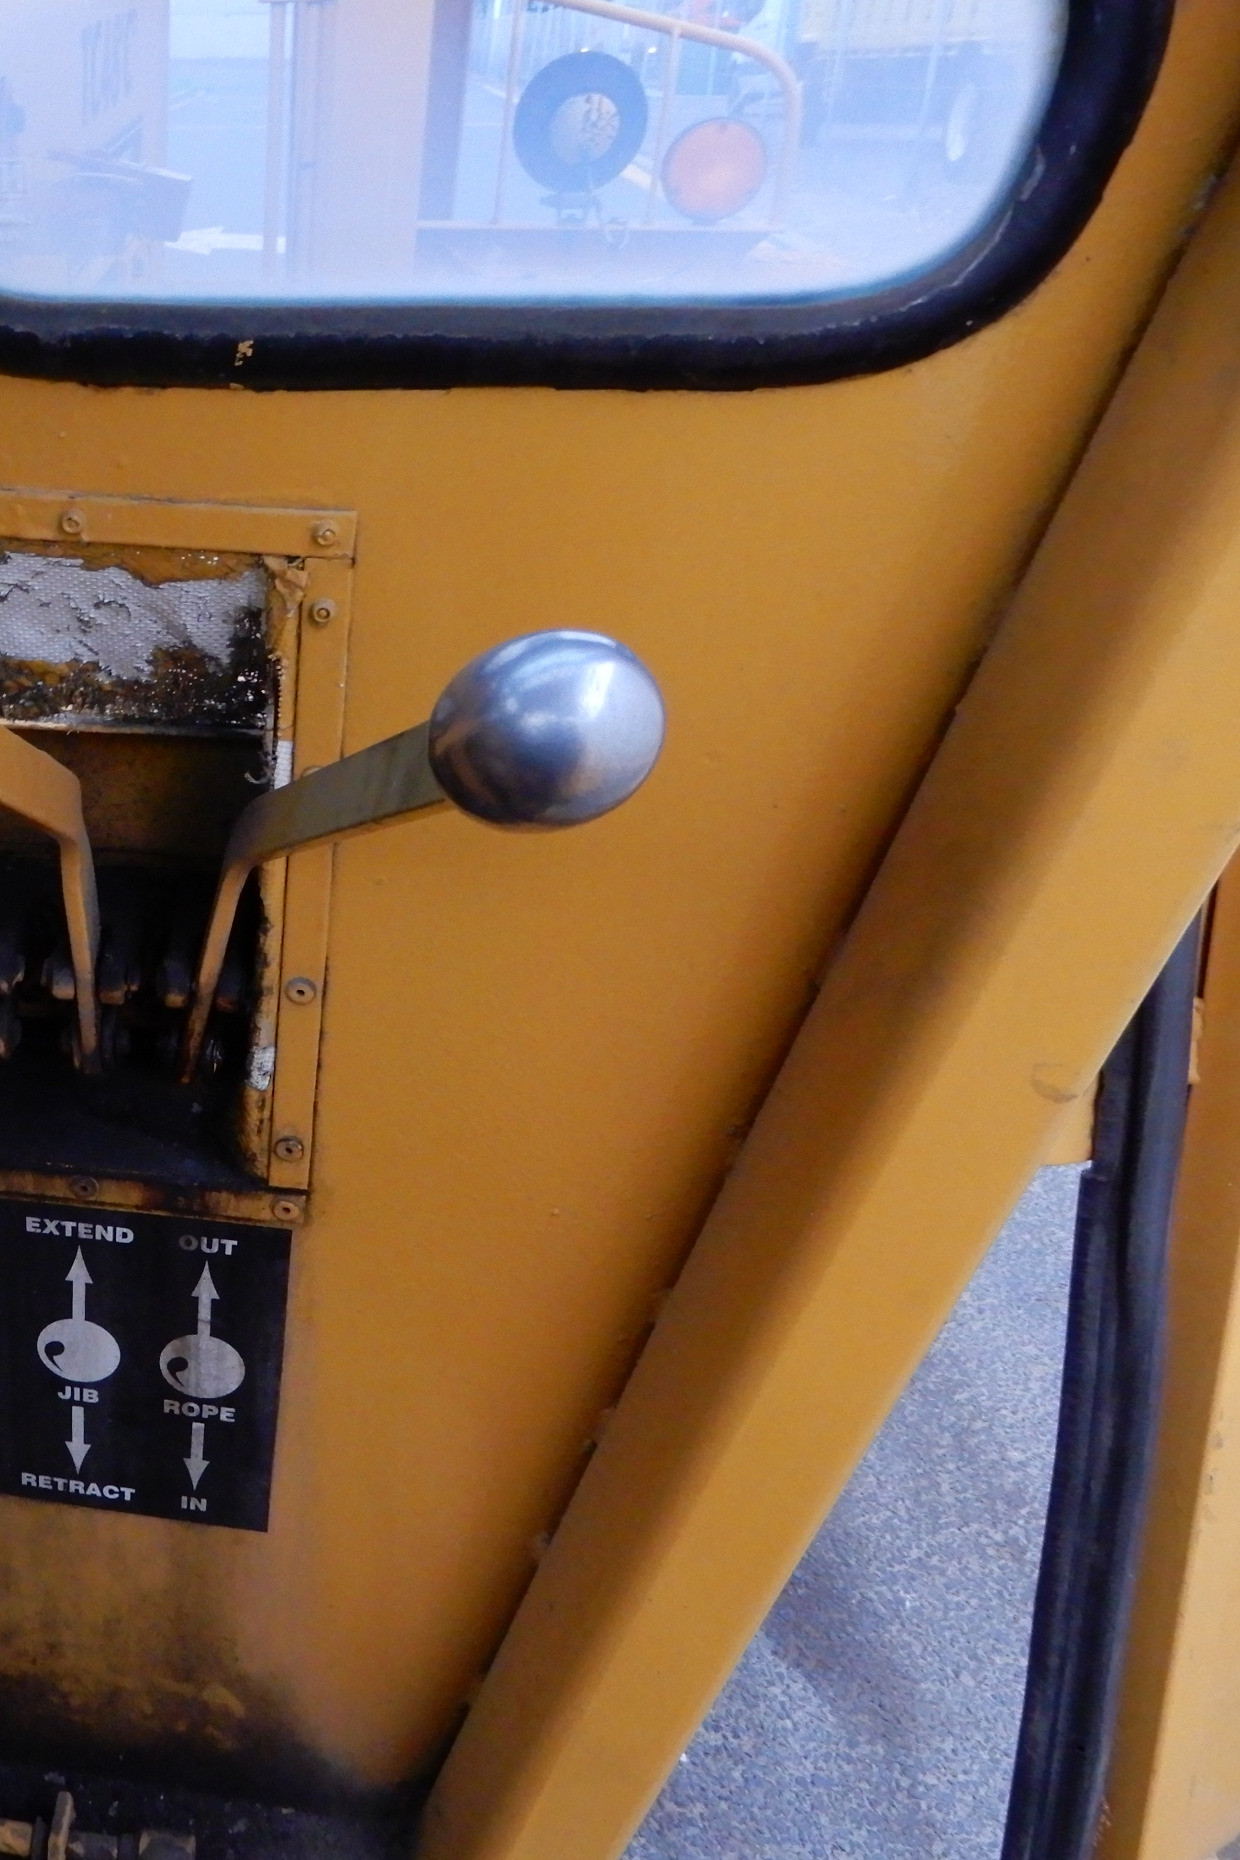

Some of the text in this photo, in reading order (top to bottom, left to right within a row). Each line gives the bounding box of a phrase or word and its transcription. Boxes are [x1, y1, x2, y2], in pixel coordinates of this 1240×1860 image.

[25, 1216, 135, 1244] EXTEND
[178, 1234, 238, 1256] OUT
[57, 1386, 99, 1403] JIB
[163, 1399, 235, 1422] ROPE
[21, 1472, 136, 1501] RETRACT
[180, 1495, 207, 1512] IN
